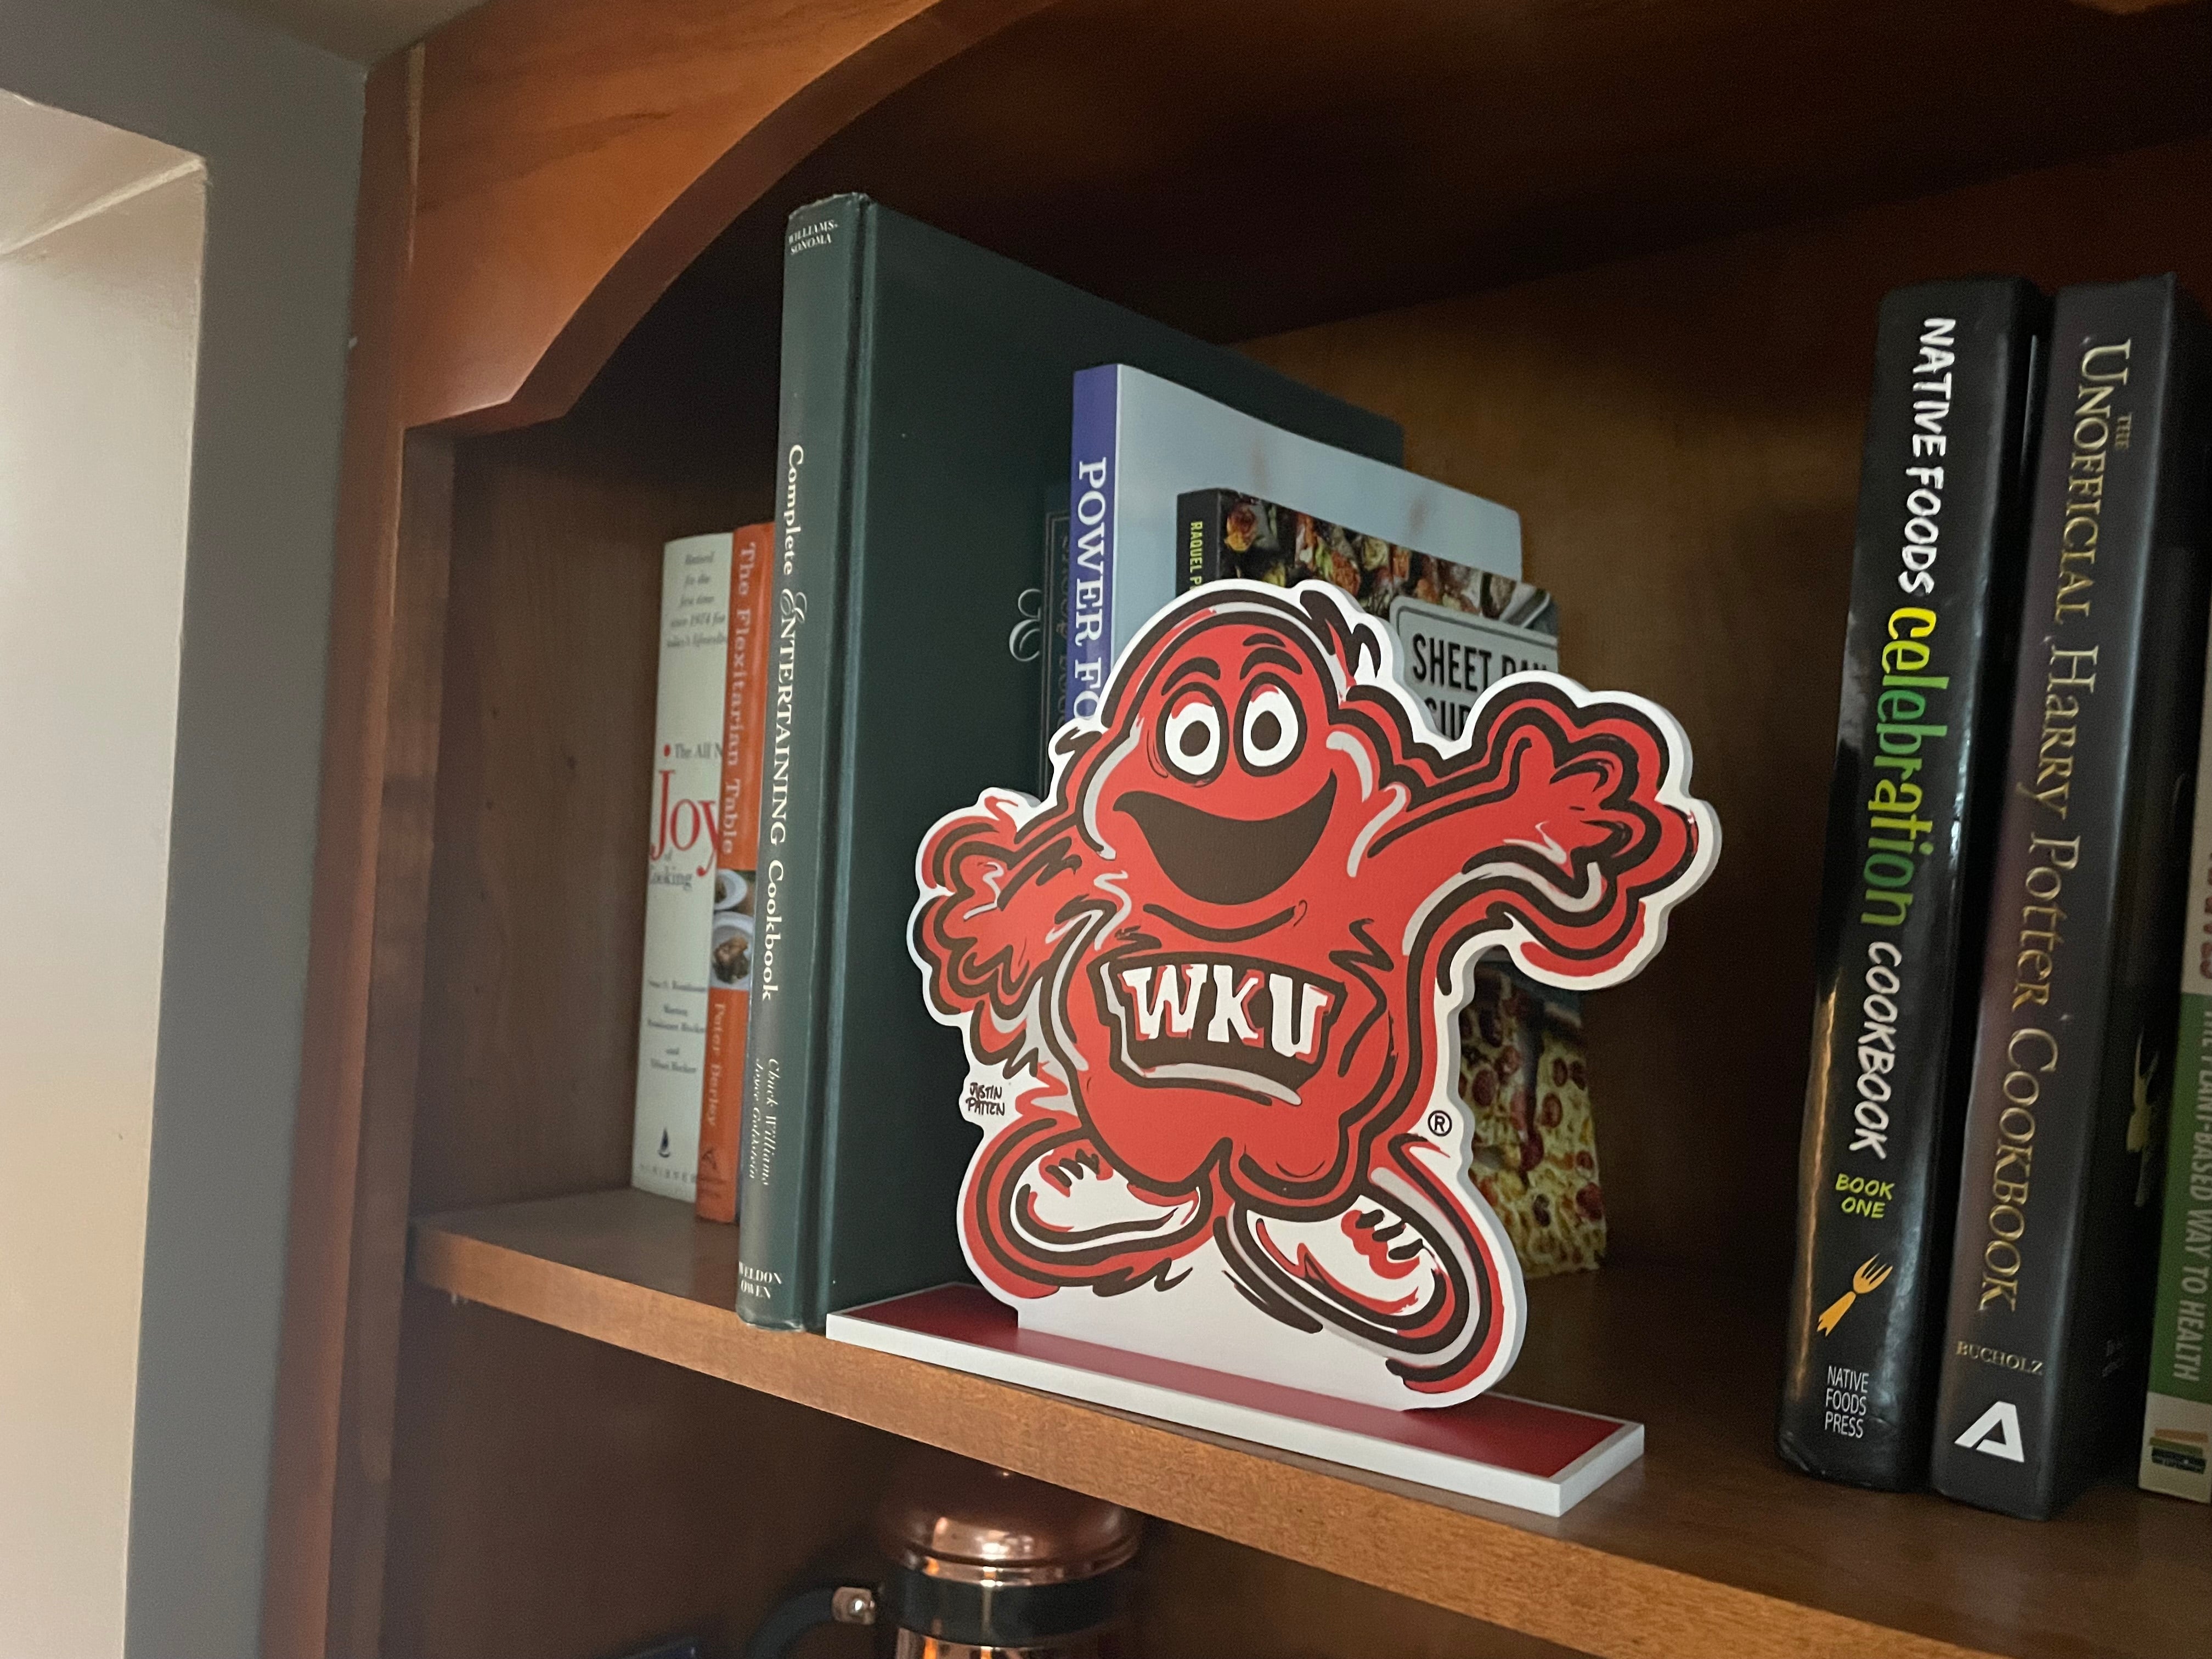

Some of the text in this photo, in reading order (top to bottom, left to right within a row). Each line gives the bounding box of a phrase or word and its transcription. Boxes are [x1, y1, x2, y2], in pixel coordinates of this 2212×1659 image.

[2114, 412, 2132, 451] THE
[784, 444, 804, 575] Complete
[1075, 458, 1107, 647] POWER
[1189, 521, 1203, 573] RAQUEL
[1412, 633, 1492, 692] SHEET
[721, 541, 756, 854] The Flexitarian Table
[1849, 318, 1956, 1161] NATIVE FOODS Celebration COOKBOOK
[650, 769, 719, 878] Joy
[762, 860, 783, 1001] Cookbook
[1123, 963, 1328, 1059] WKU
[966, 1097, 1005, 1116] PATTEN
[970, 1082, 1002, 1101] JUSTIN
[1835, 1173, 1895, 1201] BOOK
[1841, 1197, 1886, 1219] ONE
[2181, 1266, 2210, 1294] TO
[1956, 1340, 2043, 1376] BUCHOLZ
[2174, 1300, 2207, 1381] HEALTH
[1827, 1366, 1869, 1393] NATIVE
[1824, 1411, 1864, 1438] PRESS
[1825, 1391, 1867, 1417] FOODS
